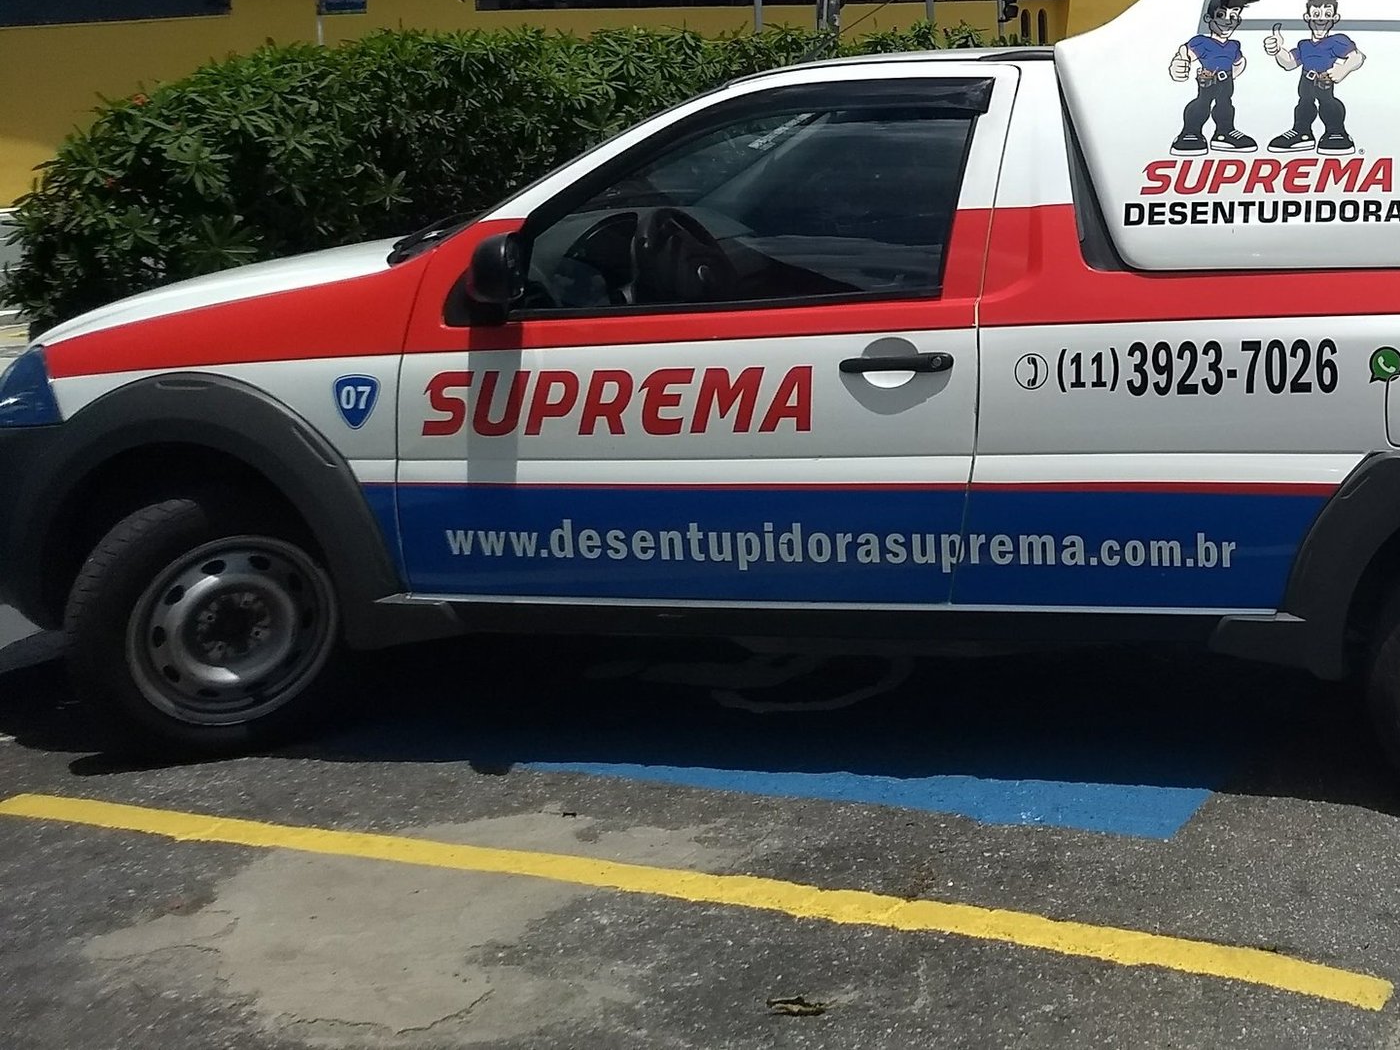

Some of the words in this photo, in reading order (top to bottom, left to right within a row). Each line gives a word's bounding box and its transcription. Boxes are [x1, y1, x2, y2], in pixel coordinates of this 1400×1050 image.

[1139, 157, 1395, 196] SUPREMA
[339, 384, 373, 411] 07
[420, 364, 815, 438] SUPREMA
[445, 518, 1237, 574] www.desentupidorasuprema.com.br
